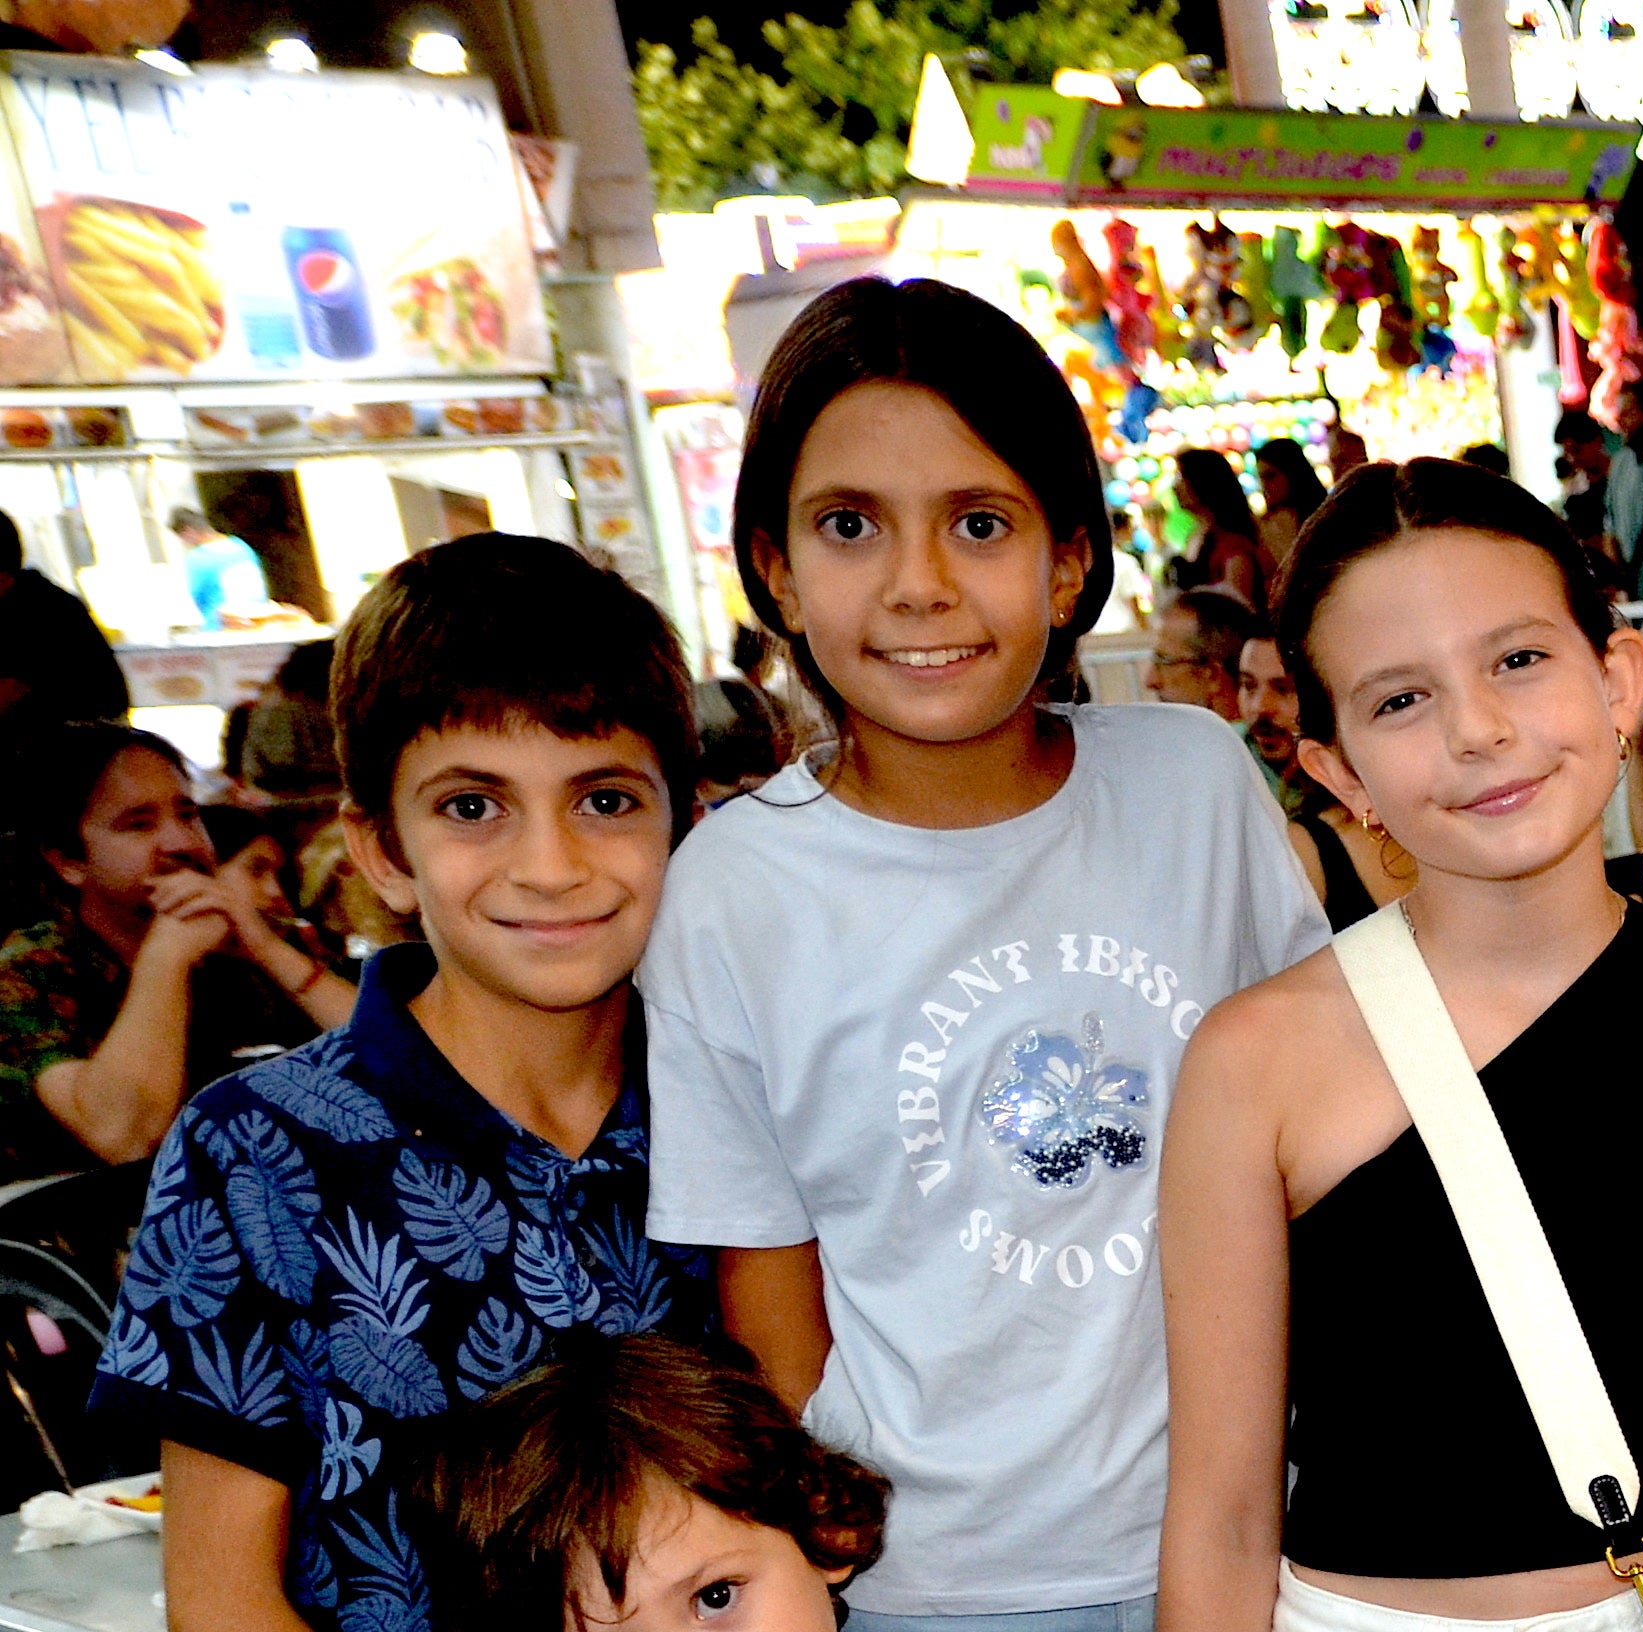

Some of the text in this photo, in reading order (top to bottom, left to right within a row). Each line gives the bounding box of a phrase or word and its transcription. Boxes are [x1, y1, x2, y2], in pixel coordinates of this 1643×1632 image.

[897, 933, 1204, 1197] VIBRANT IBISC
[959, 1208, 1157, 1288] OOMS
